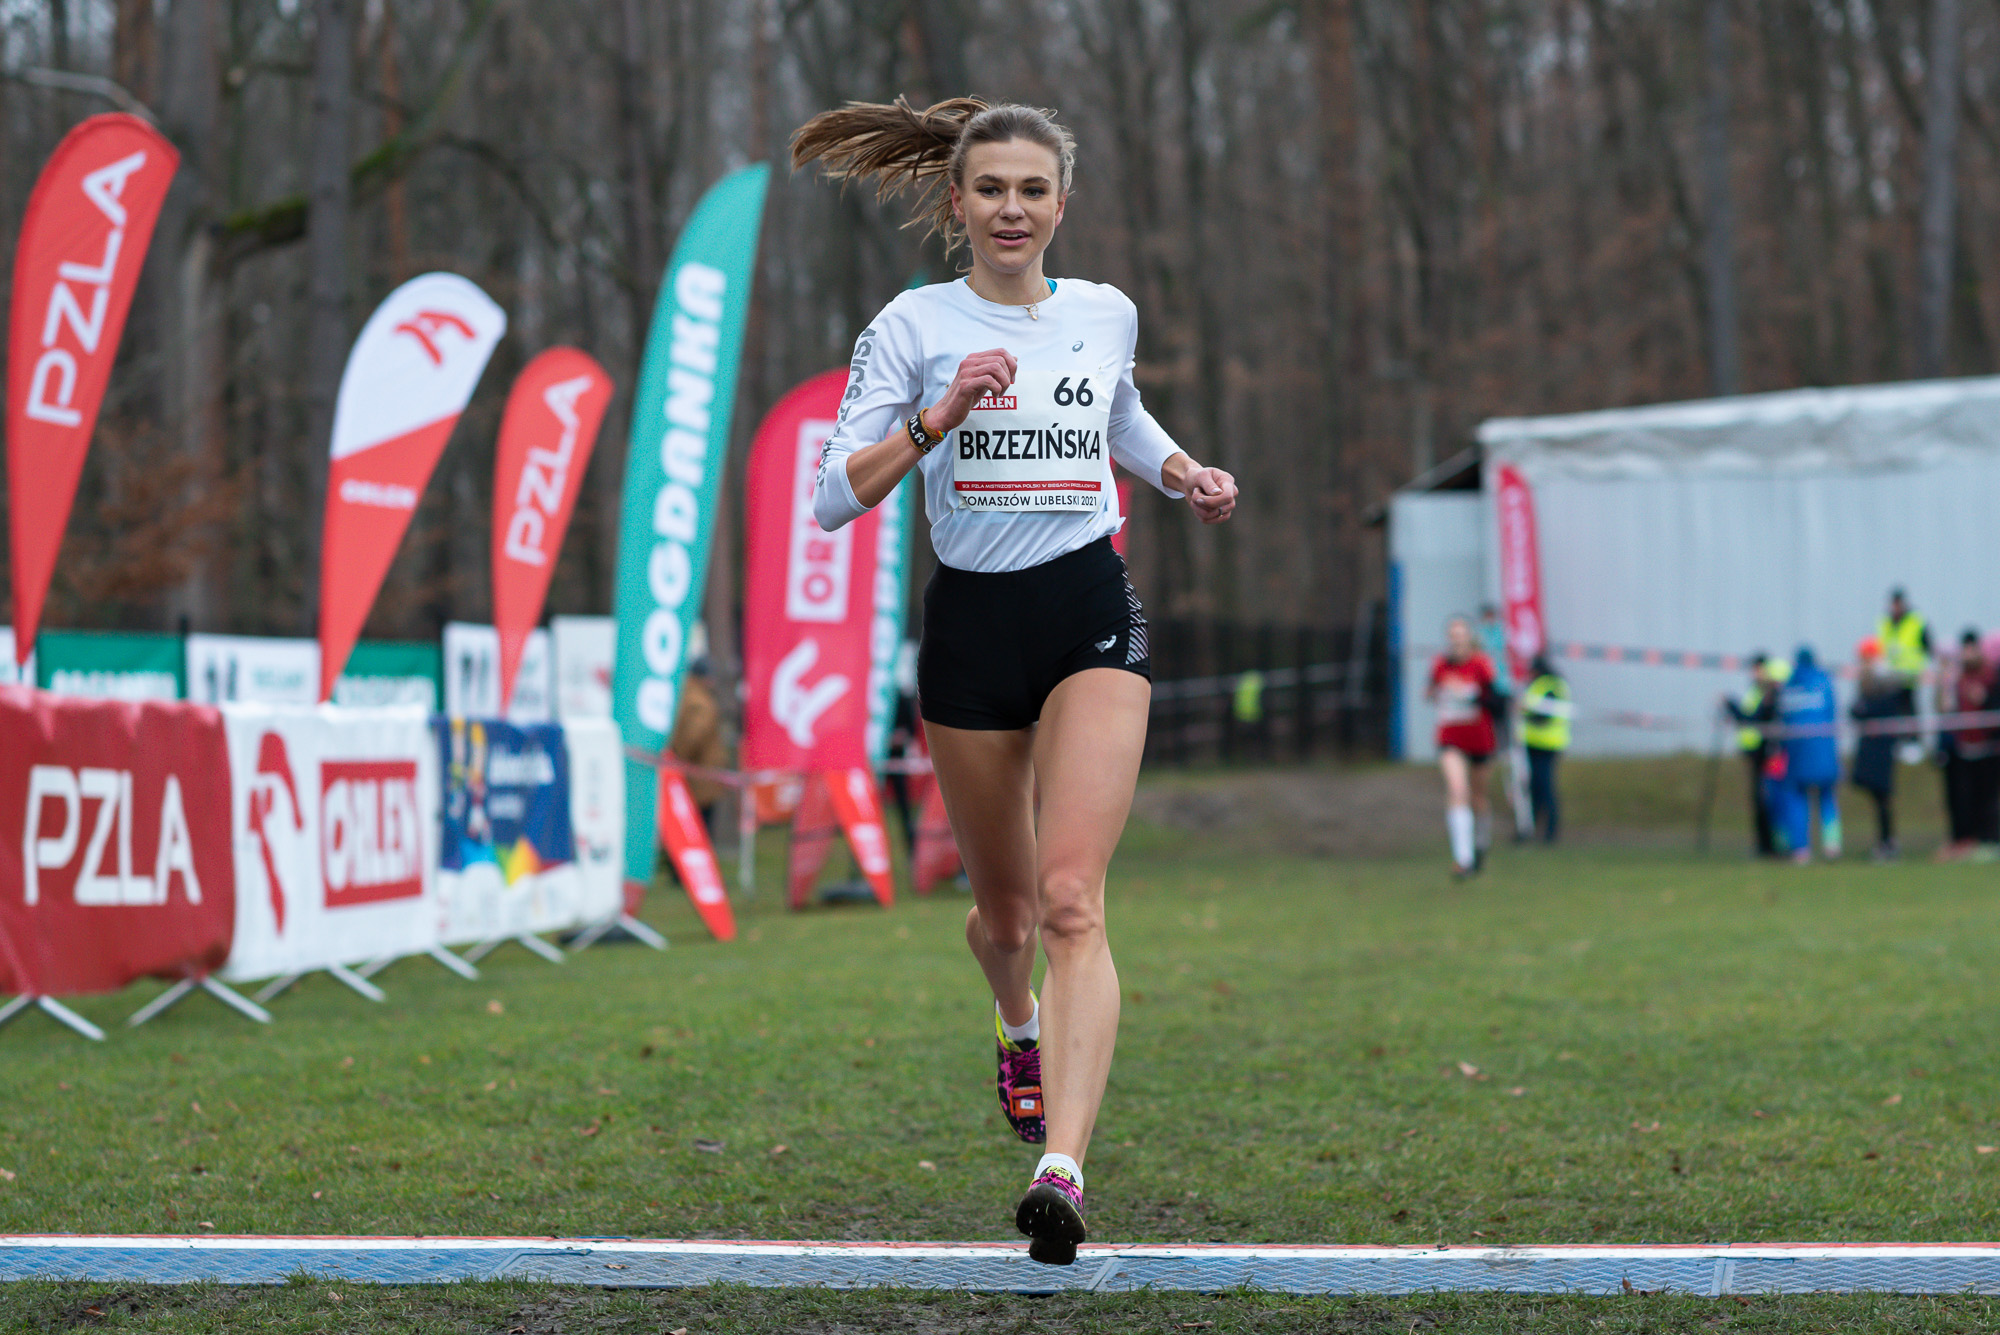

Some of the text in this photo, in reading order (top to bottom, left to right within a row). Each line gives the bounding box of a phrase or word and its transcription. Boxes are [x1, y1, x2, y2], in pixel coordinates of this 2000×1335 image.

[26, 151, 146, 427] PZLA
[959, 423, 1100, 460] BRZEZIŃSKA
[1054, 376, 1094, 407] 66
[505, 375, 593, 566] PZLA
[637, 262, 727, 735] BOGDANKA
[962, 493, 1097, 506] TOMASZÓW LUBELSKI 2021
[23, 764, 202, 906] PZLA
[325, 778, 419, 890] ORLEN
